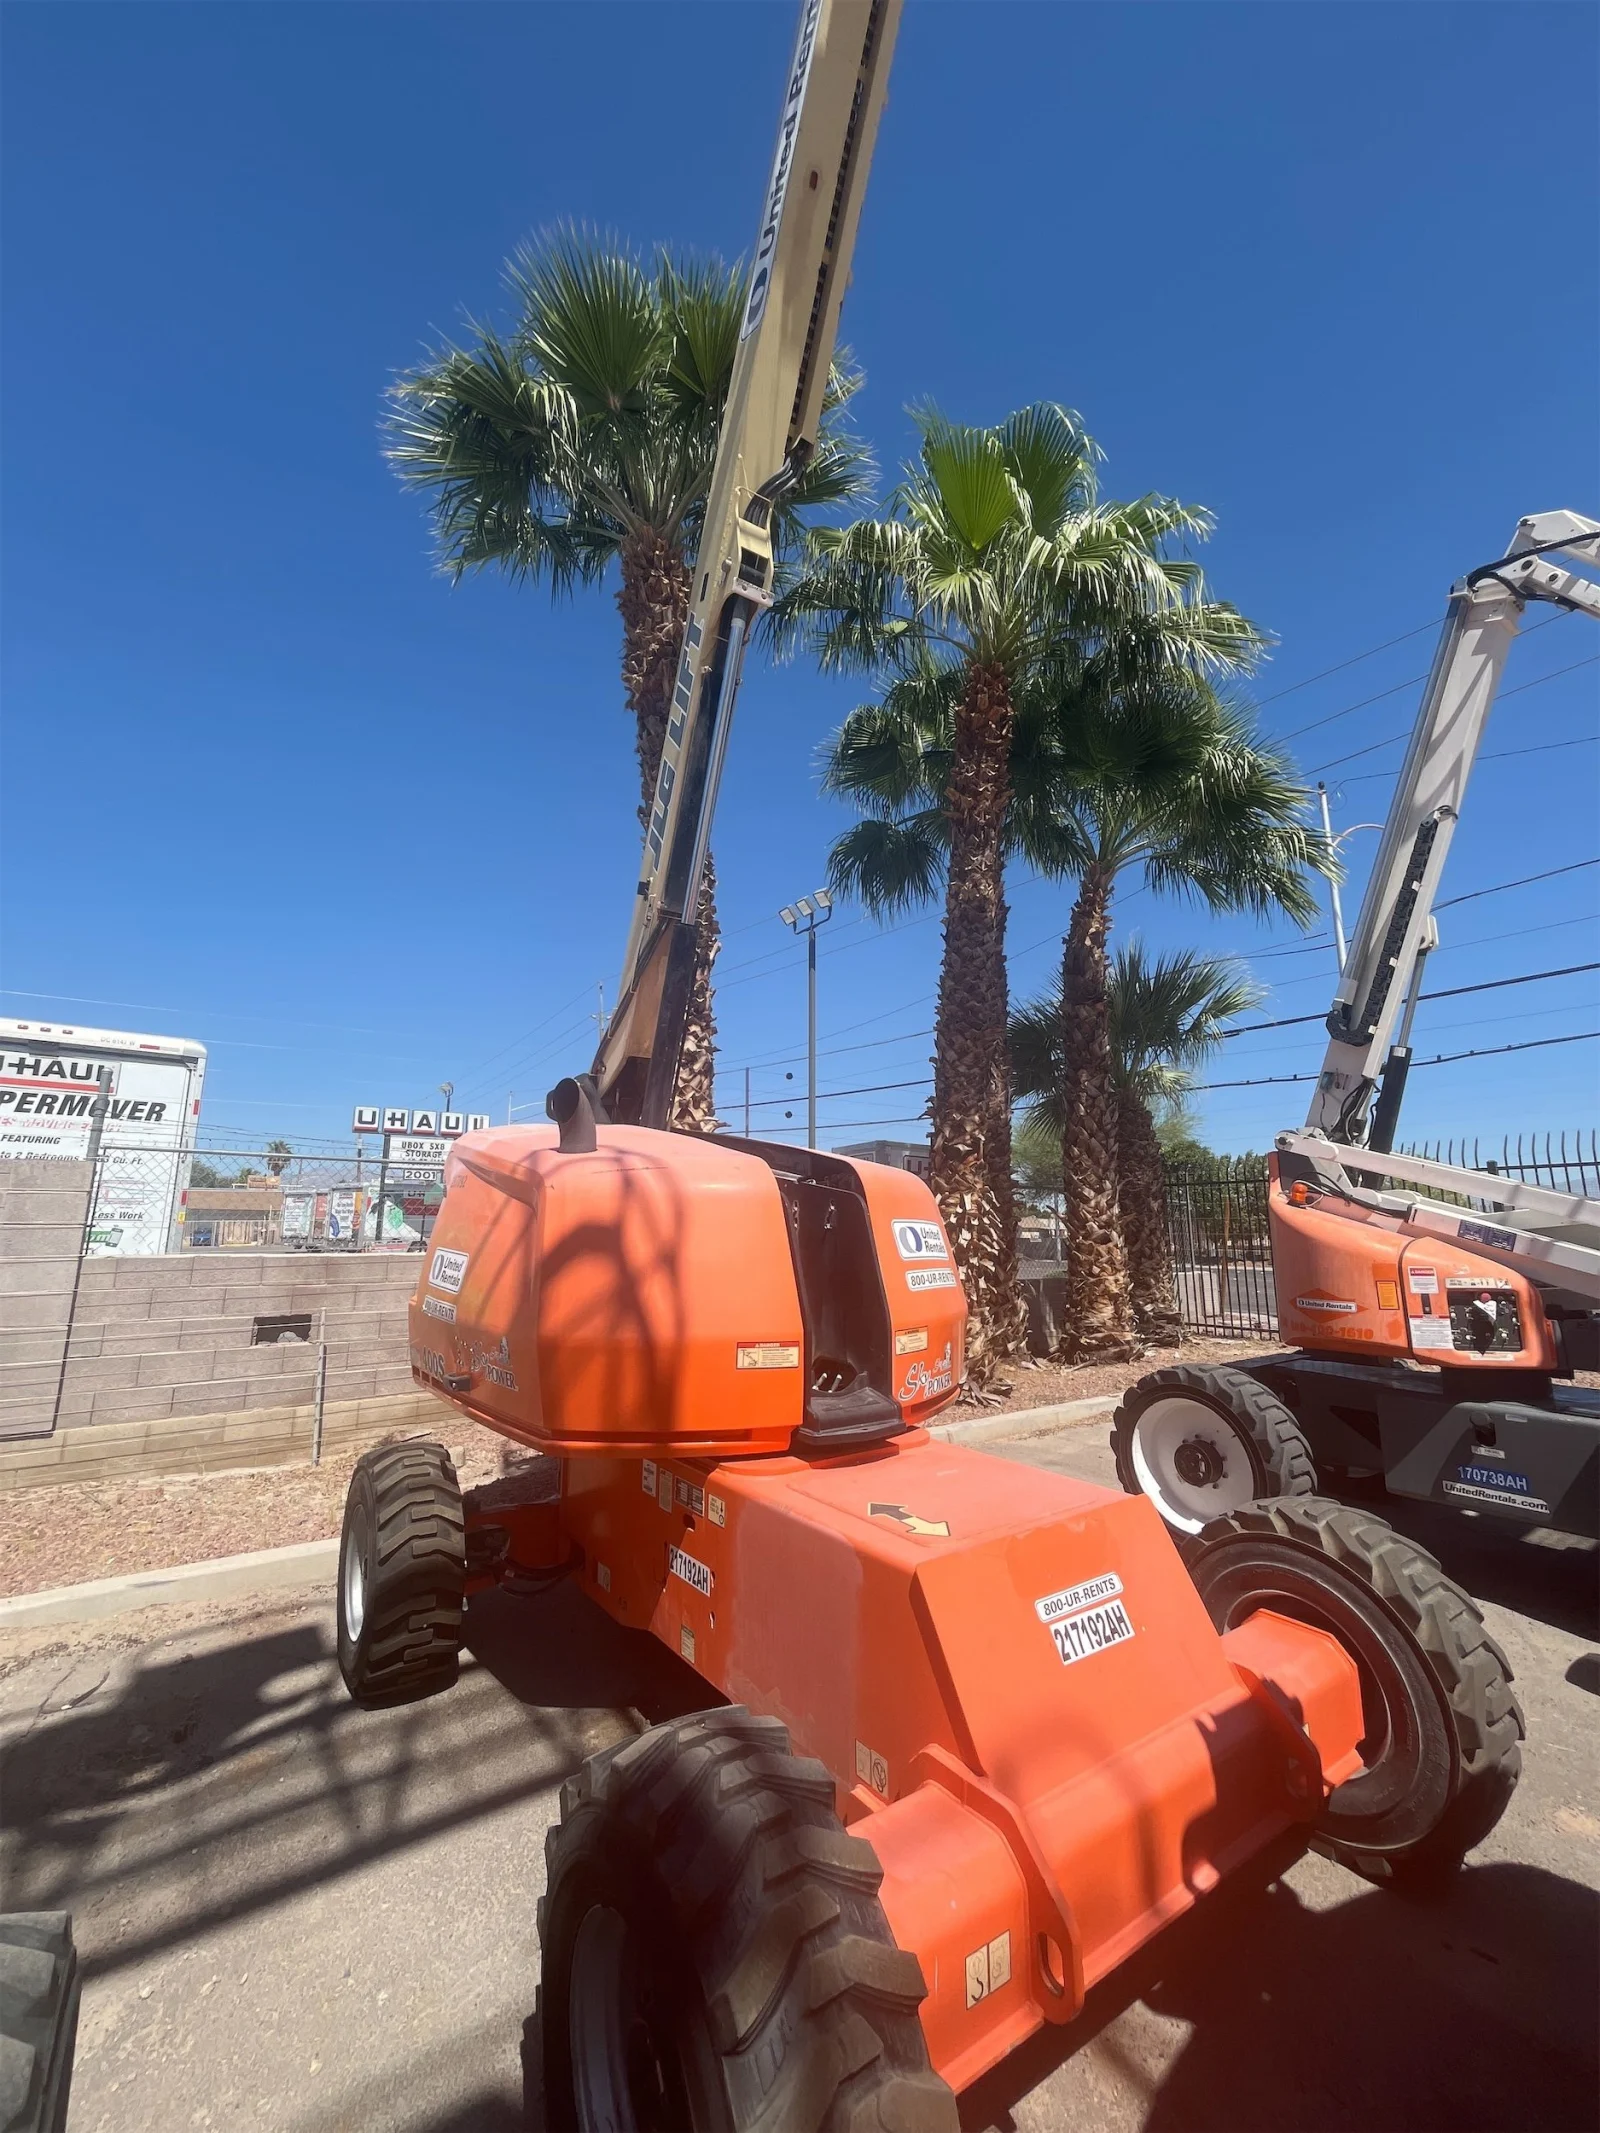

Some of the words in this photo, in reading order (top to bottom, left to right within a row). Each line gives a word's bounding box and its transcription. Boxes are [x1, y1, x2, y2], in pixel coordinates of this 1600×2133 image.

[759, 110, 798, 260] United
[648, 758, 677, 872] JLG
[668, 612, 704, 750] LIFT
[0, 1134, 61, 1145] FEATURING
[401, 1141, 424, 1150] UBOX
[429, 1142, 446, 1150] 5X8
[112, 1156, 128, 1164] Cu.
[131, 1157, 144, 1165] Ft.
[405, 1150, 443, 1158] STORAGE
[405, 1170, 436, 1179] 2001
[119, 1211, 144, 1219] Work
[920, 1226, 941, 1241] United
[924, 1240, 946, 1253] Rentals
[443, 1256, 464, 1273] United
[439, 1270, 461, 1287] Rentals
[1304, 1300, 1324, 1308] United
[1325, 1301, 1353, 1310] Rentals
[486, 1364, 518, 1391] POWER
[926, 1371, 952, 1397] POWER
[1457, 1465, 1528, 1491] 170738AH
[1444, 1482, 1549, 1511] UnitedRentals.com
[670, 1547, 709, 1594] 217192AH
[1043, 1577, 1117, 1616] 800-UR-RENTS
[1053, 1604, 1131, 1662] 217192AH
